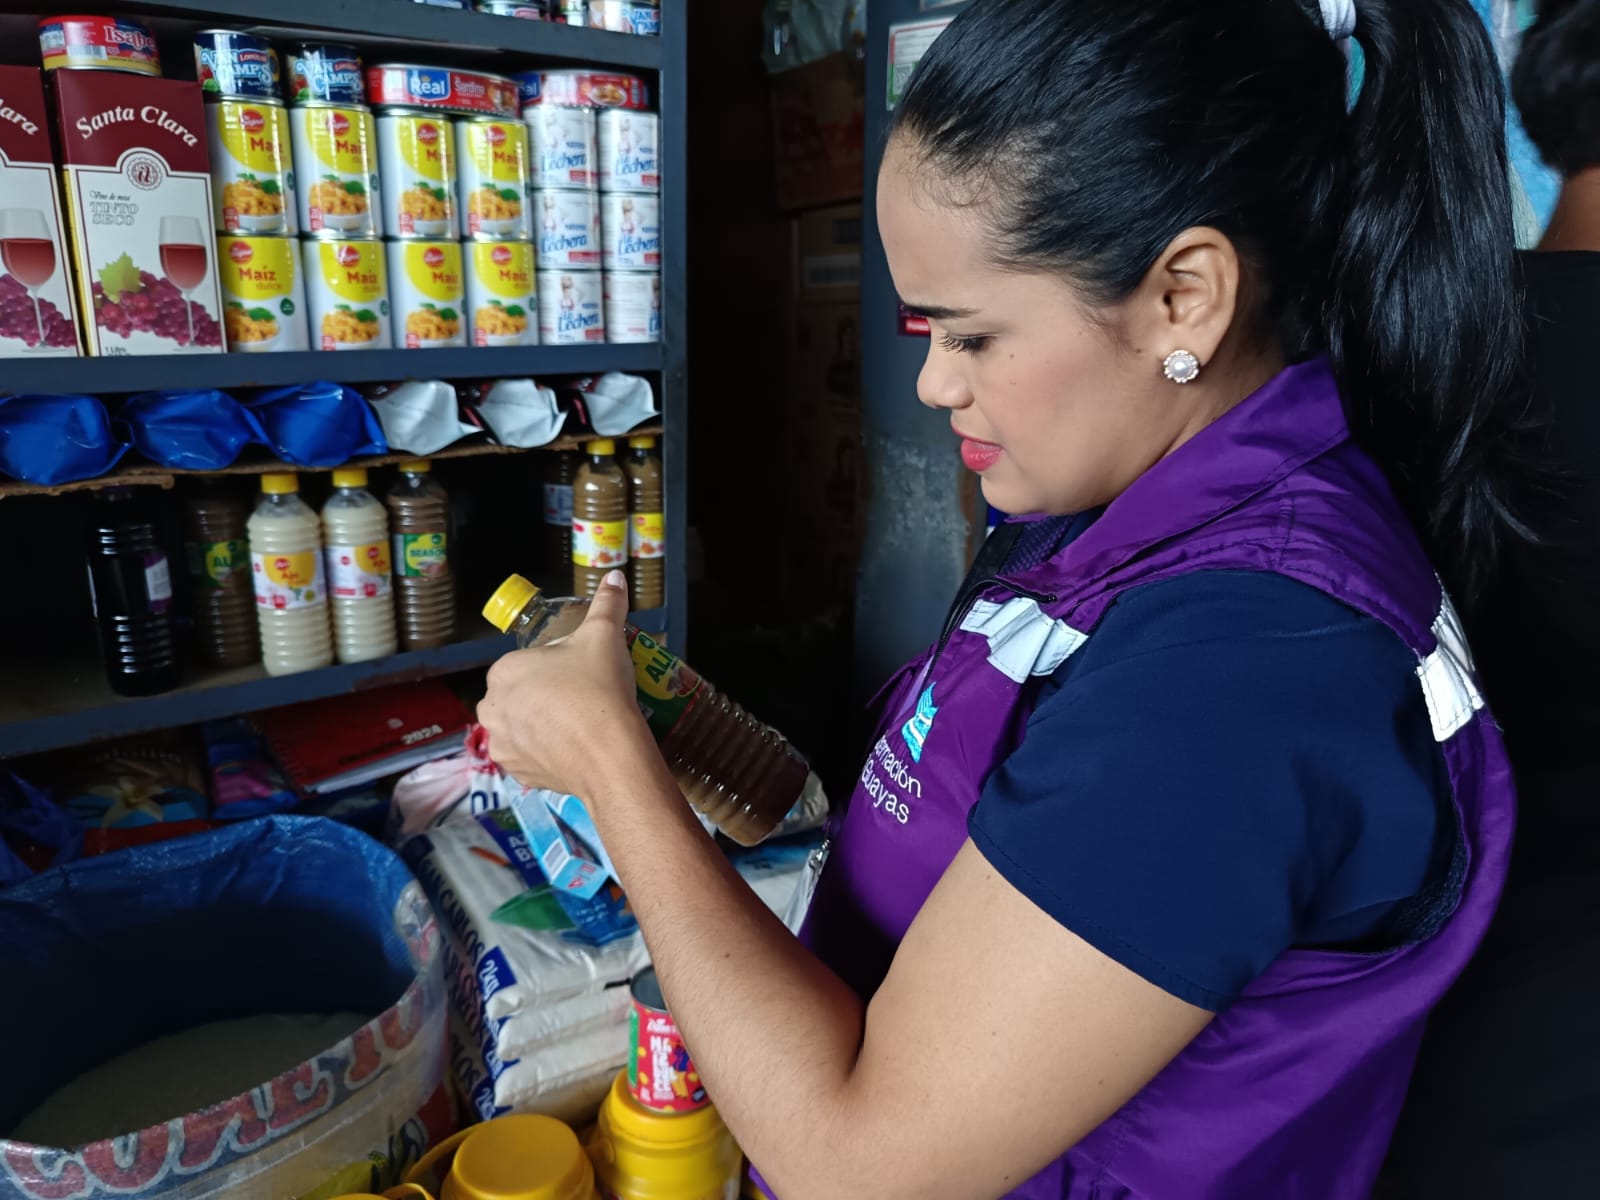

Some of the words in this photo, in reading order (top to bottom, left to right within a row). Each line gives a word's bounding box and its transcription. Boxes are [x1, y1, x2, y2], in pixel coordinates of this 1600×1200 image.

[410, 77, 446, 96] Real
[76, 105, 135, 140] Santa
[140, 105, 199, 148] Clara
[402, 725, 443, 745] 2024
